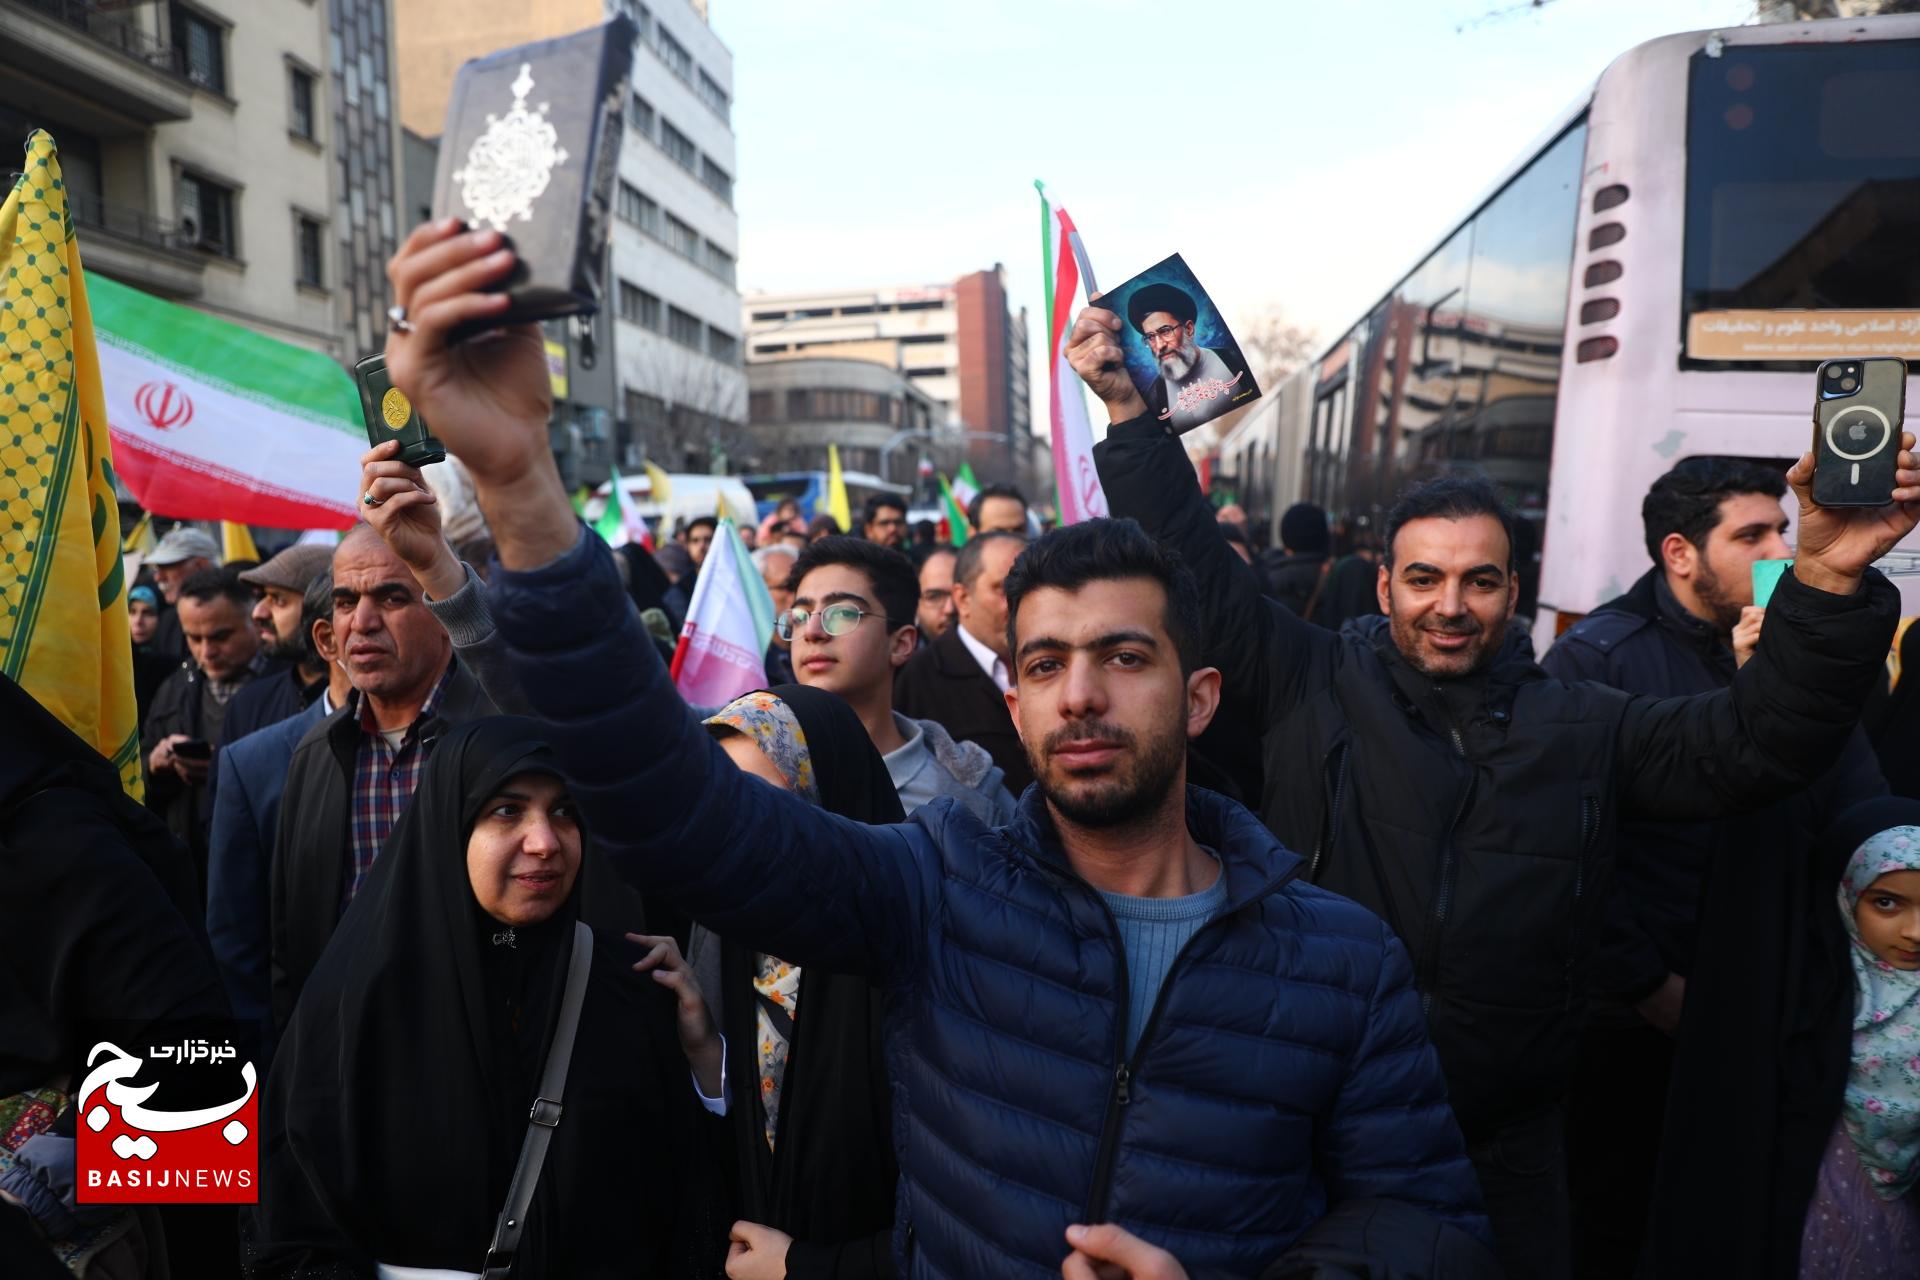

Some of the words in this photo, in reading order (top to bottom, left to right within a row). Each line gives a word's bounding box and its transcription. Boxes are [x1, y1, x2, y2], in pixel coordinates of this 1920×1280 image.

[1702, 319, 1761, 335] تحقیقات
[1775, 319, 1806, 337] علوم
[1810, 319, 1842, 336] واحد
[1846, 318, 1896, 337] اسلامی
